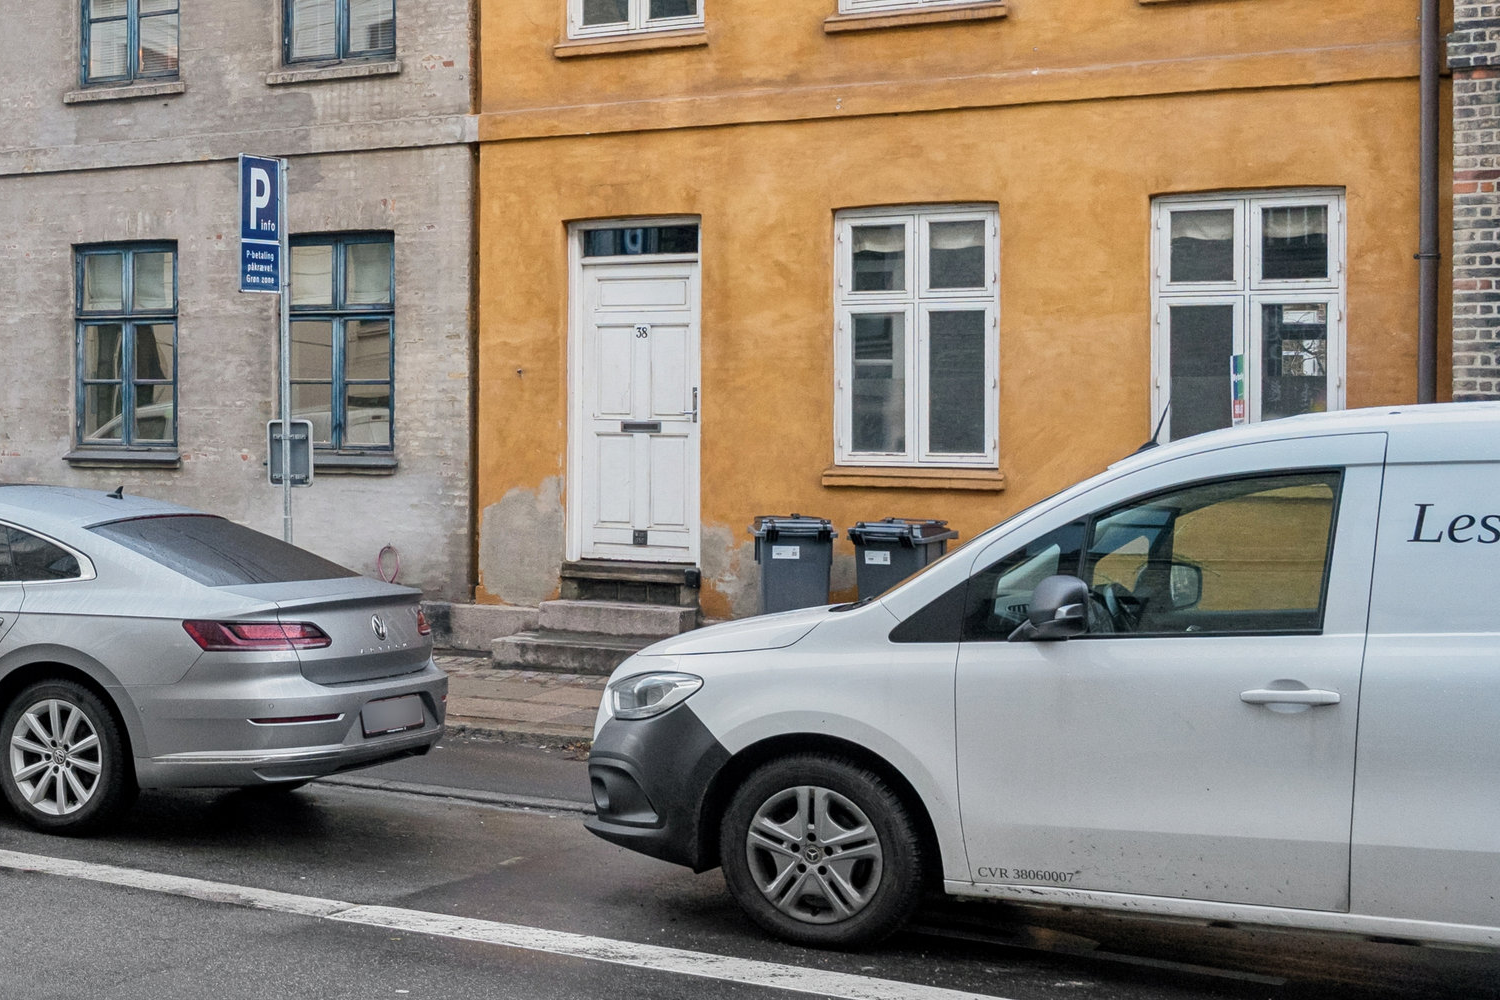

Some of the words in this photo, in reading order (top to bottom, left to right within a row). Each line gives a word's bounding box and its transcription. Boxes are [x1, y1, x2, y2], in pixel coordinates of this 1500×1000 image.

[250, 167, 271, 230] P
[260, 219, 276, 232] info
[246, 250, 275, 262] P-betaling
[247, 262, 273, 273] påkrævet
[246, 274, 260, 284] Grøn
[261, 275, 275, 284] zone
[636, 327, 648, 338] 38
[978, 867, 1009, 879] CVR
[1012, 868, 1074, 882] 38060007
